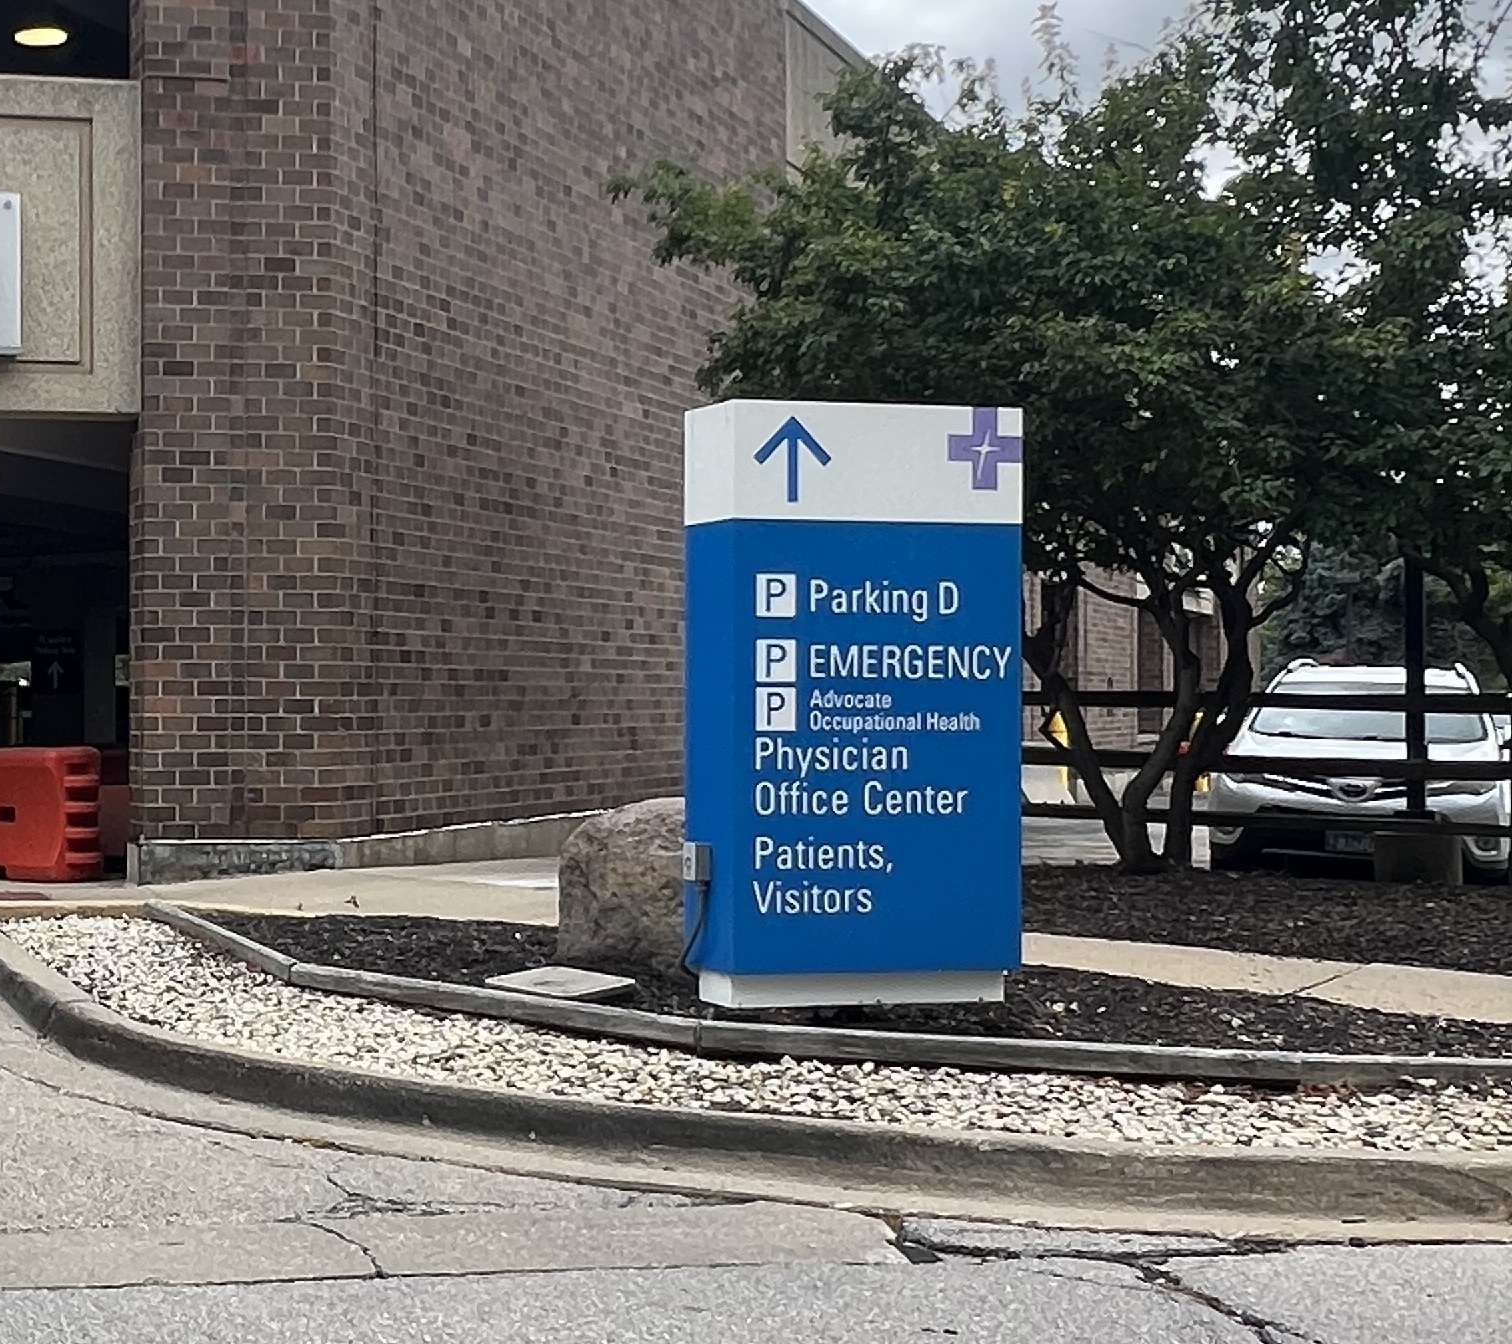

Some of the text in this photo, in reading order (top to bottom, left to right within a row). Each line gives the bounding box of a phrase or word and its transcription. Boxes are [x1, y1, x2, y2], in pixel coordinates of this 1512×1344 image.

[765, 578, 960, 623] P Parking D
[765, 643, 1013, 680] P EMERGENCY
[765, 691, 787, 726] P
[809, 688, 892, 709] Advocate
[809, 710, 981, 733] Occupational Health
[754, 736, 908, 778] Physician
[754, 780, 969, 816] Office Center
[754, 836, 894, 874] Patients,
[752, 879, 873, 914] Visitors
